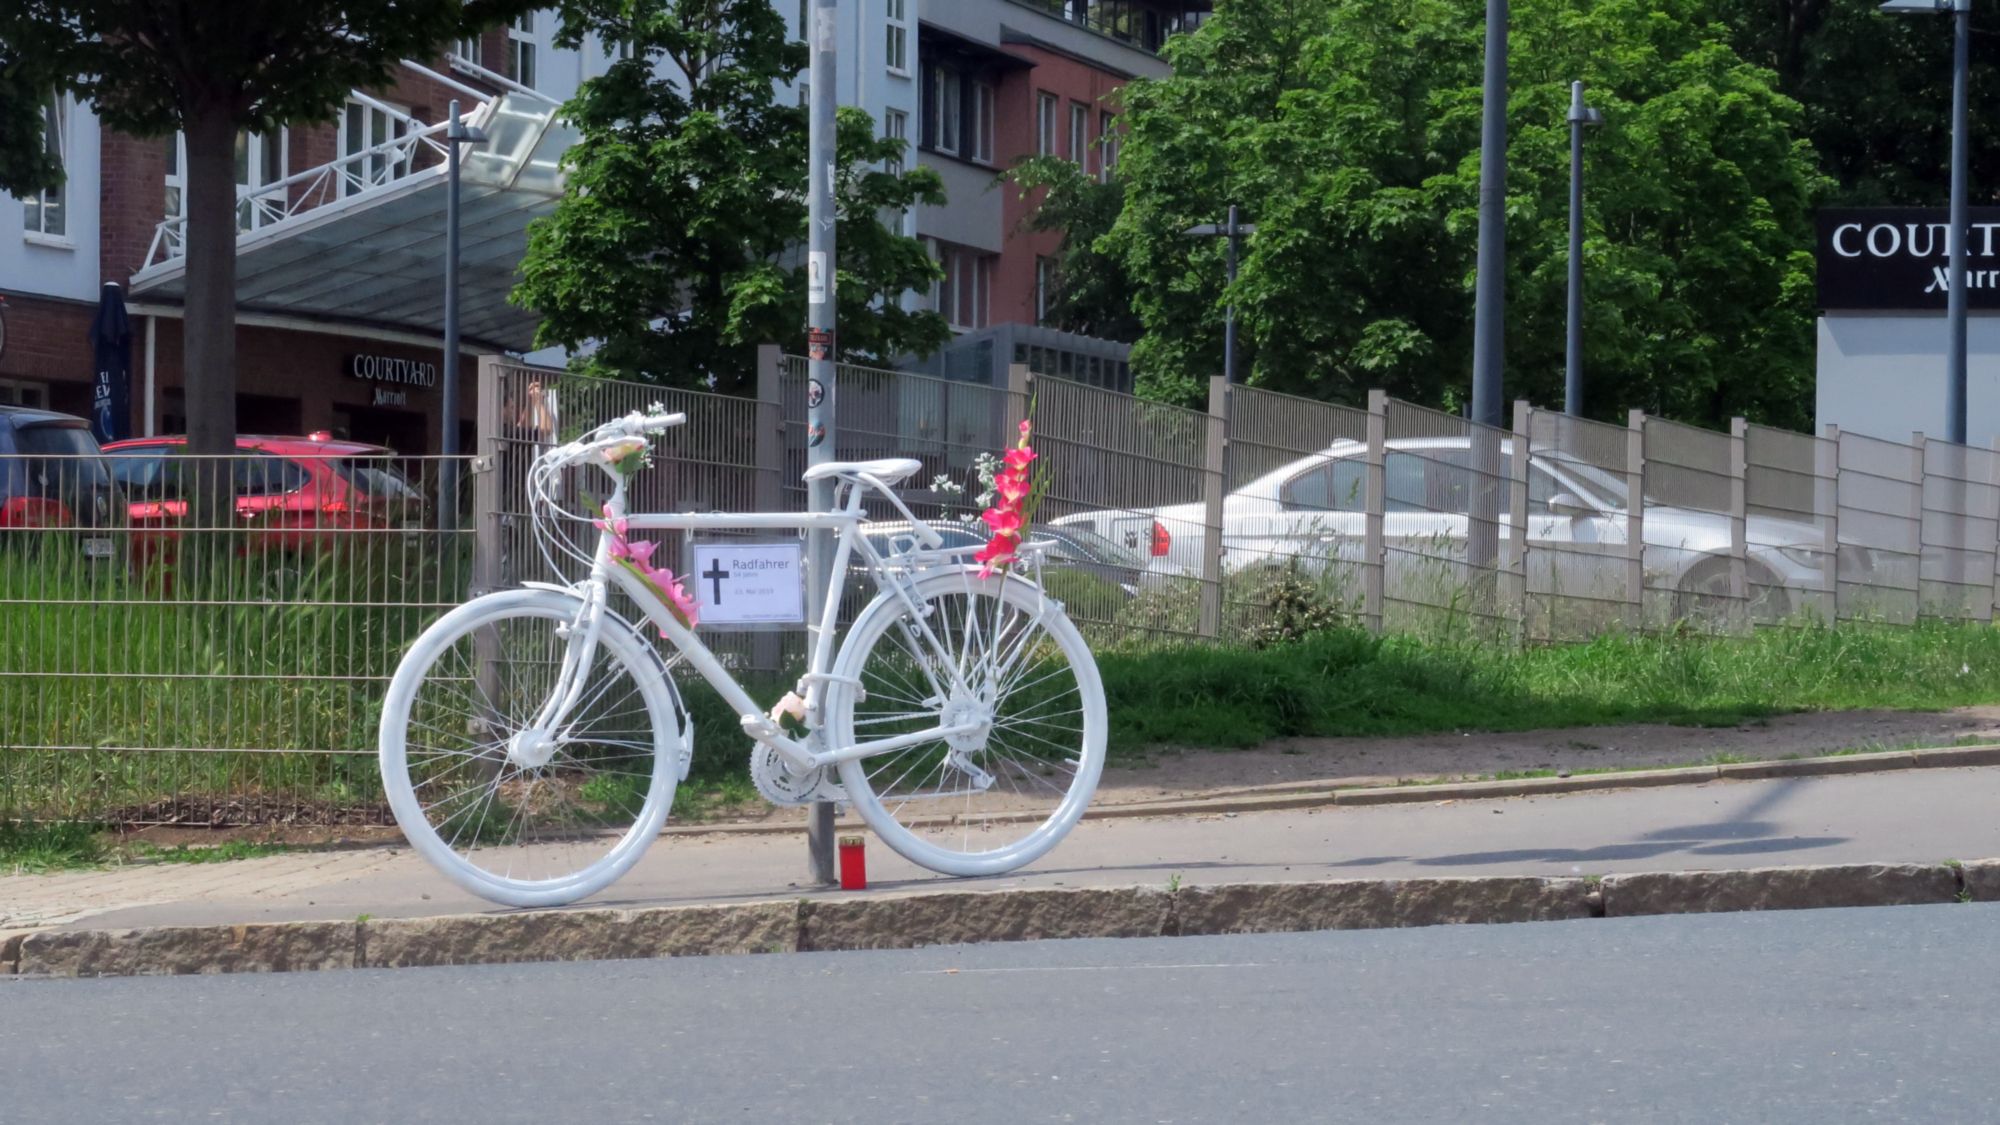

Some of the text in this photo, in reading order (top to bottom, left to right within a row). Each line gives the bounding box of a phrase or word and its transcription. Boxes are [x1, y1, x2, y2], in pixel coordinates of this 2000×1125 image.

[353, 354, 436, 388] COURTYARD
[373, 387, 407, 407] Marriott
[732, 559, 790, 570] Radfahrer
